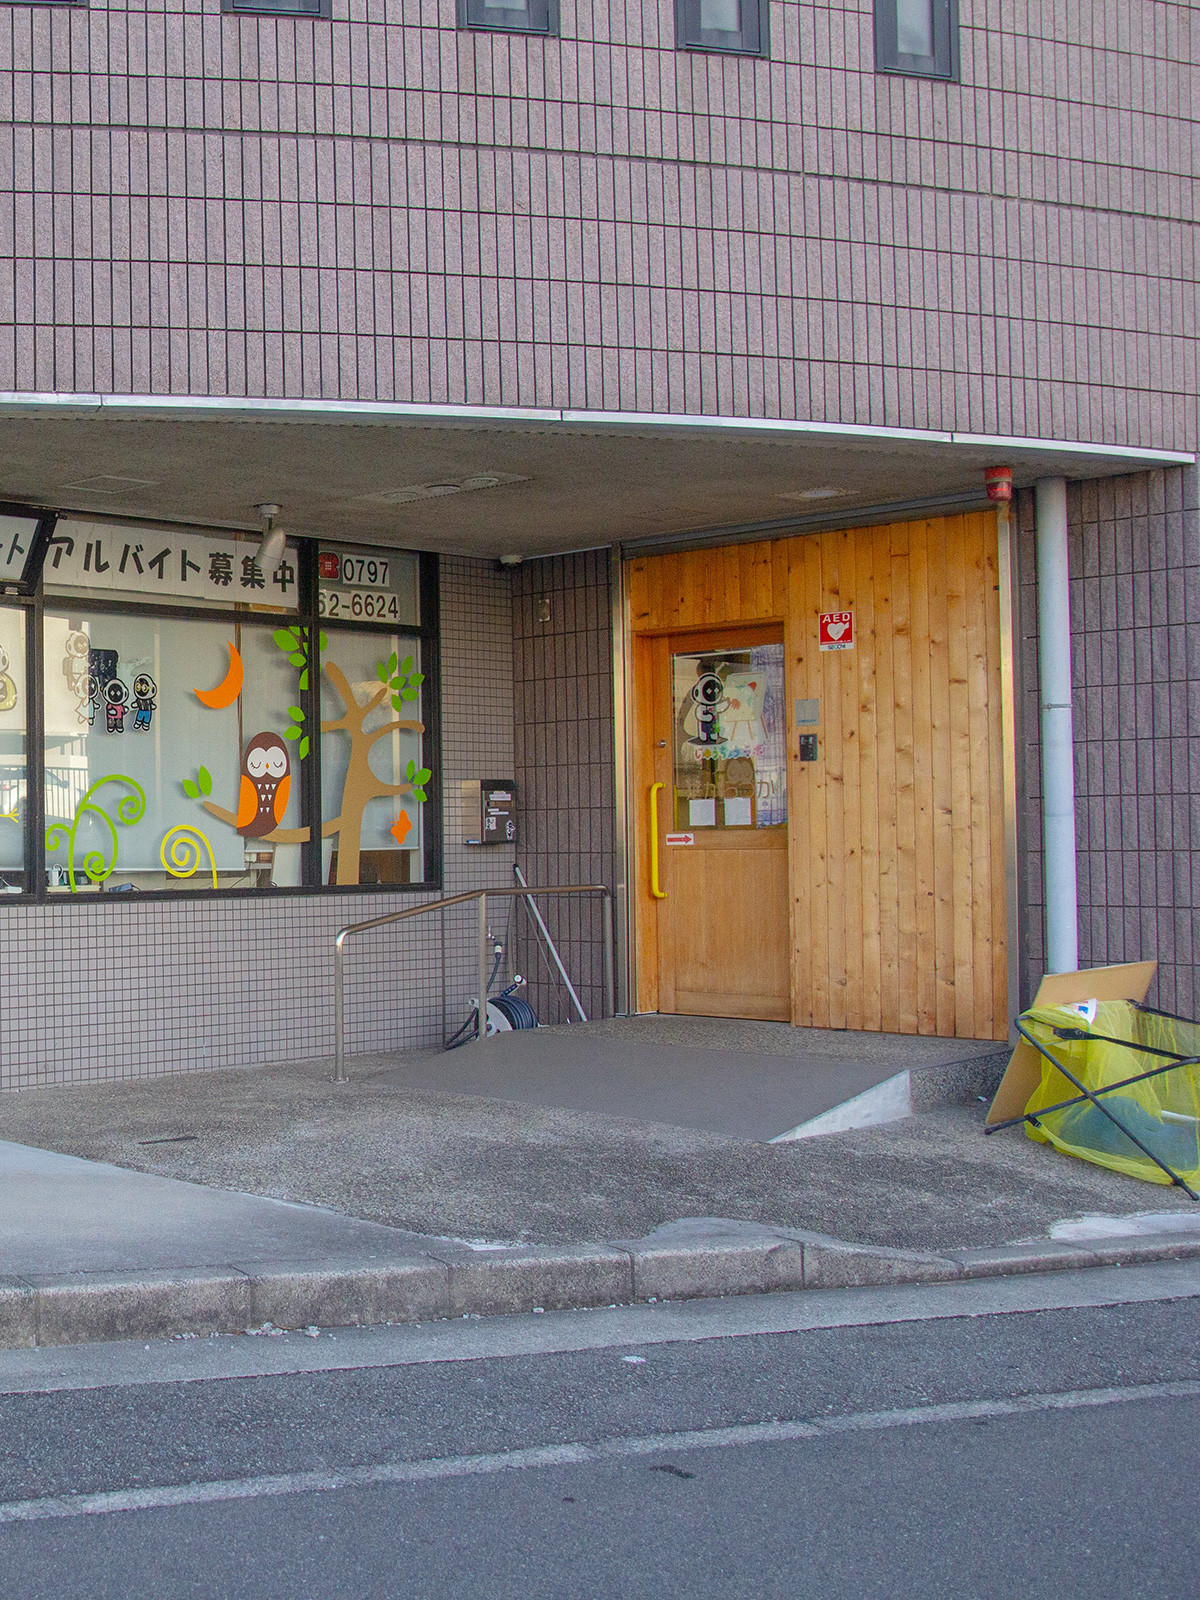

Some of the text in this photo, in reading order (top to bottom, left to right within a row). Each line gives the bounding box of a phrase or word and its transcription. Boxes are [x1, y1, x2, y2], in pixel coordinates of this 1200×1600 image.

[47, 536, 295, 593] アルバイト募集中
[343, 558, 389, 585] 0797
[822, 613, 850, 624] AED
